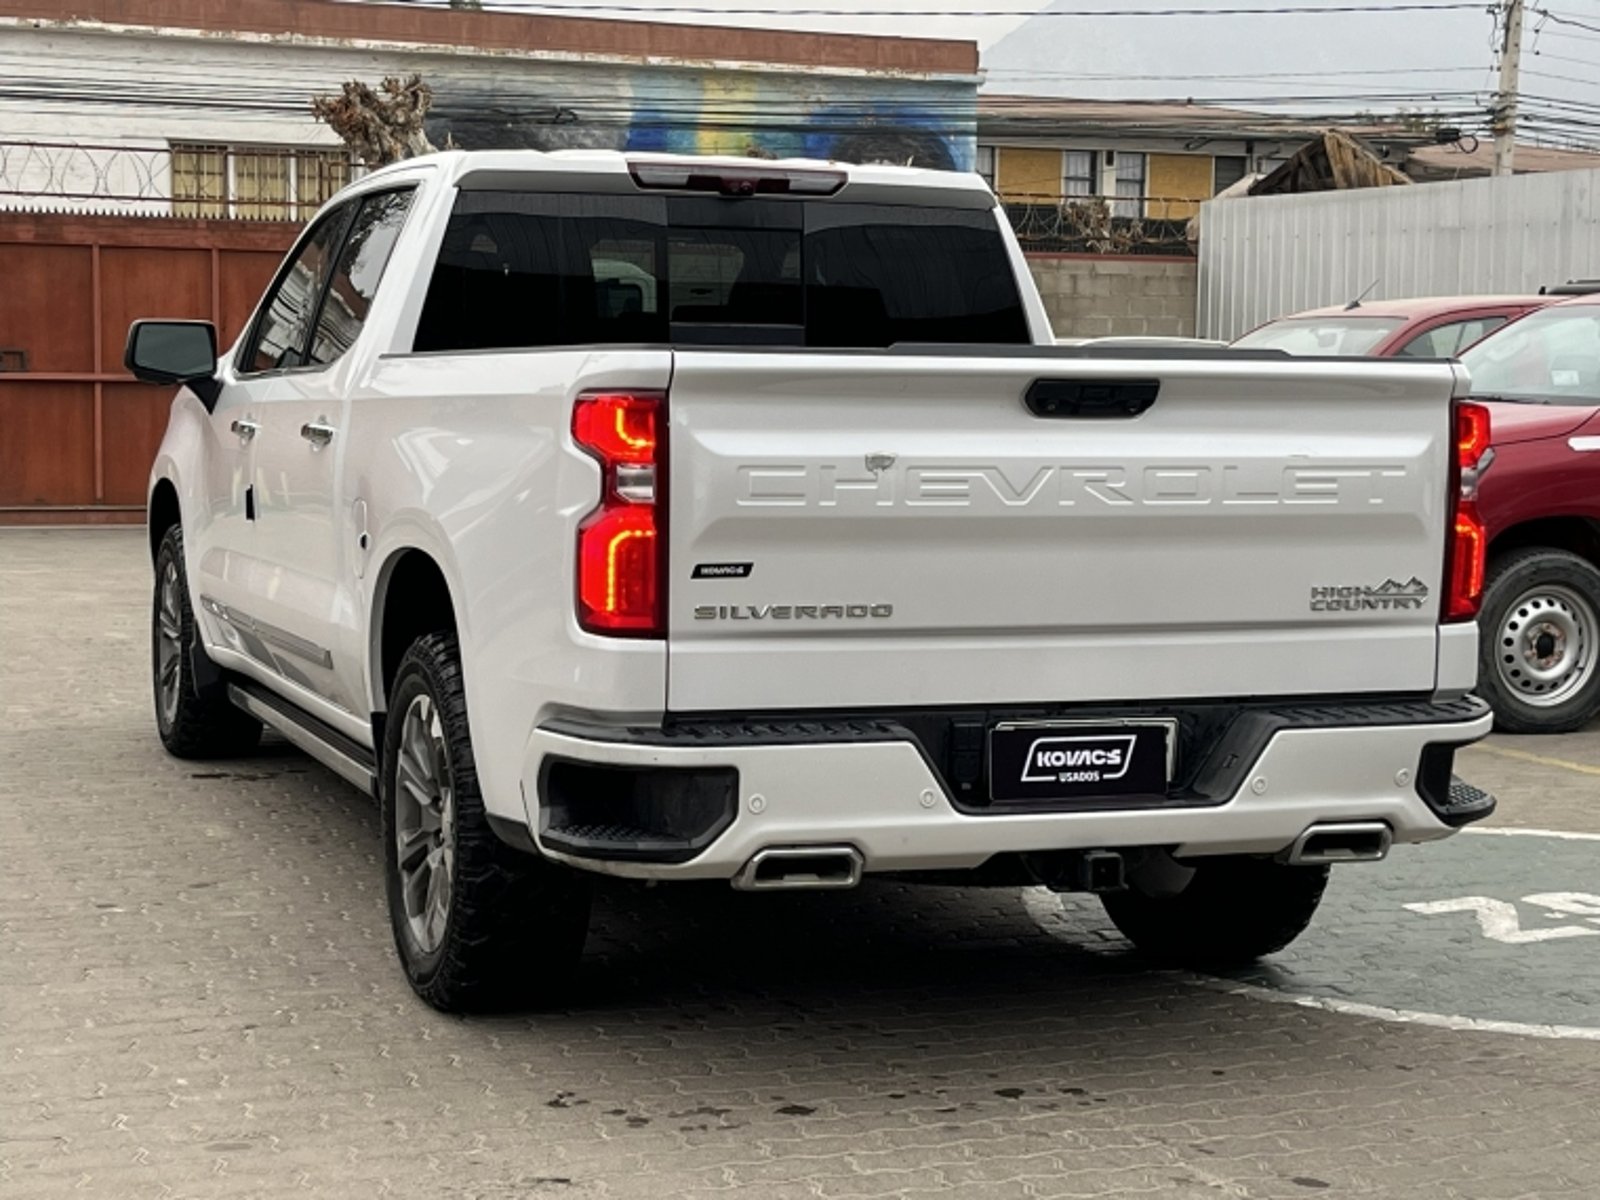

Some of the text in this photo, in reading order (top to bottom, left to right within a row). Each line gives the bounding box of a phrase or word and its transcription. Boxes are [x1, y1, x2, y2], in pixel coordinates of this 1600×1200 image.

[736, 465, 1407, 506] CHEVROLET
[1310, 586, 1374, 599] HIGH
[693, 603, 894, 620] SILVERADO
[1309, 597, 1427, 611] COUNTRY
[1036, 749, 1122, 768] KOVACS
[1059, 770, 1100, 782] SADOS
